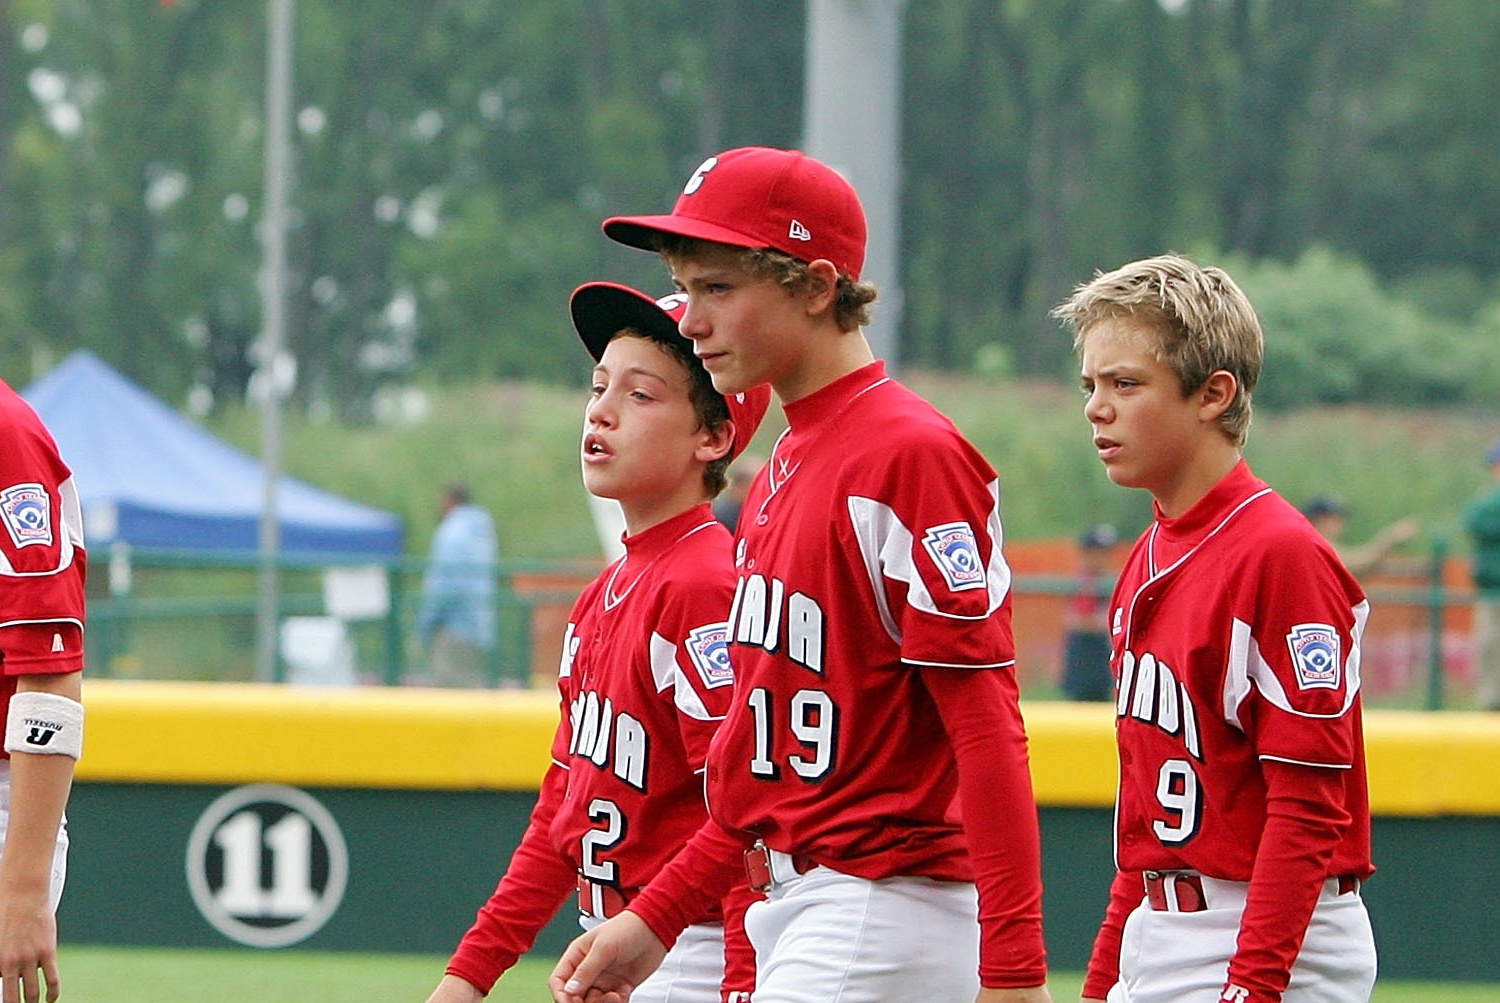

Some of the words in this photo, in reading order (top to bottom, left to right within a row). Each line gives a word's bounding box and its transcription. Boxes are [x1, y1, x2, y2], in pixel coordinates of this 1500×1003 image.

[748, 688, 836, 781] 19
[581, 799, 625, 883] 2
[1152, 759, 1201, 844] 9
[212, 811, 318, 917] 11
